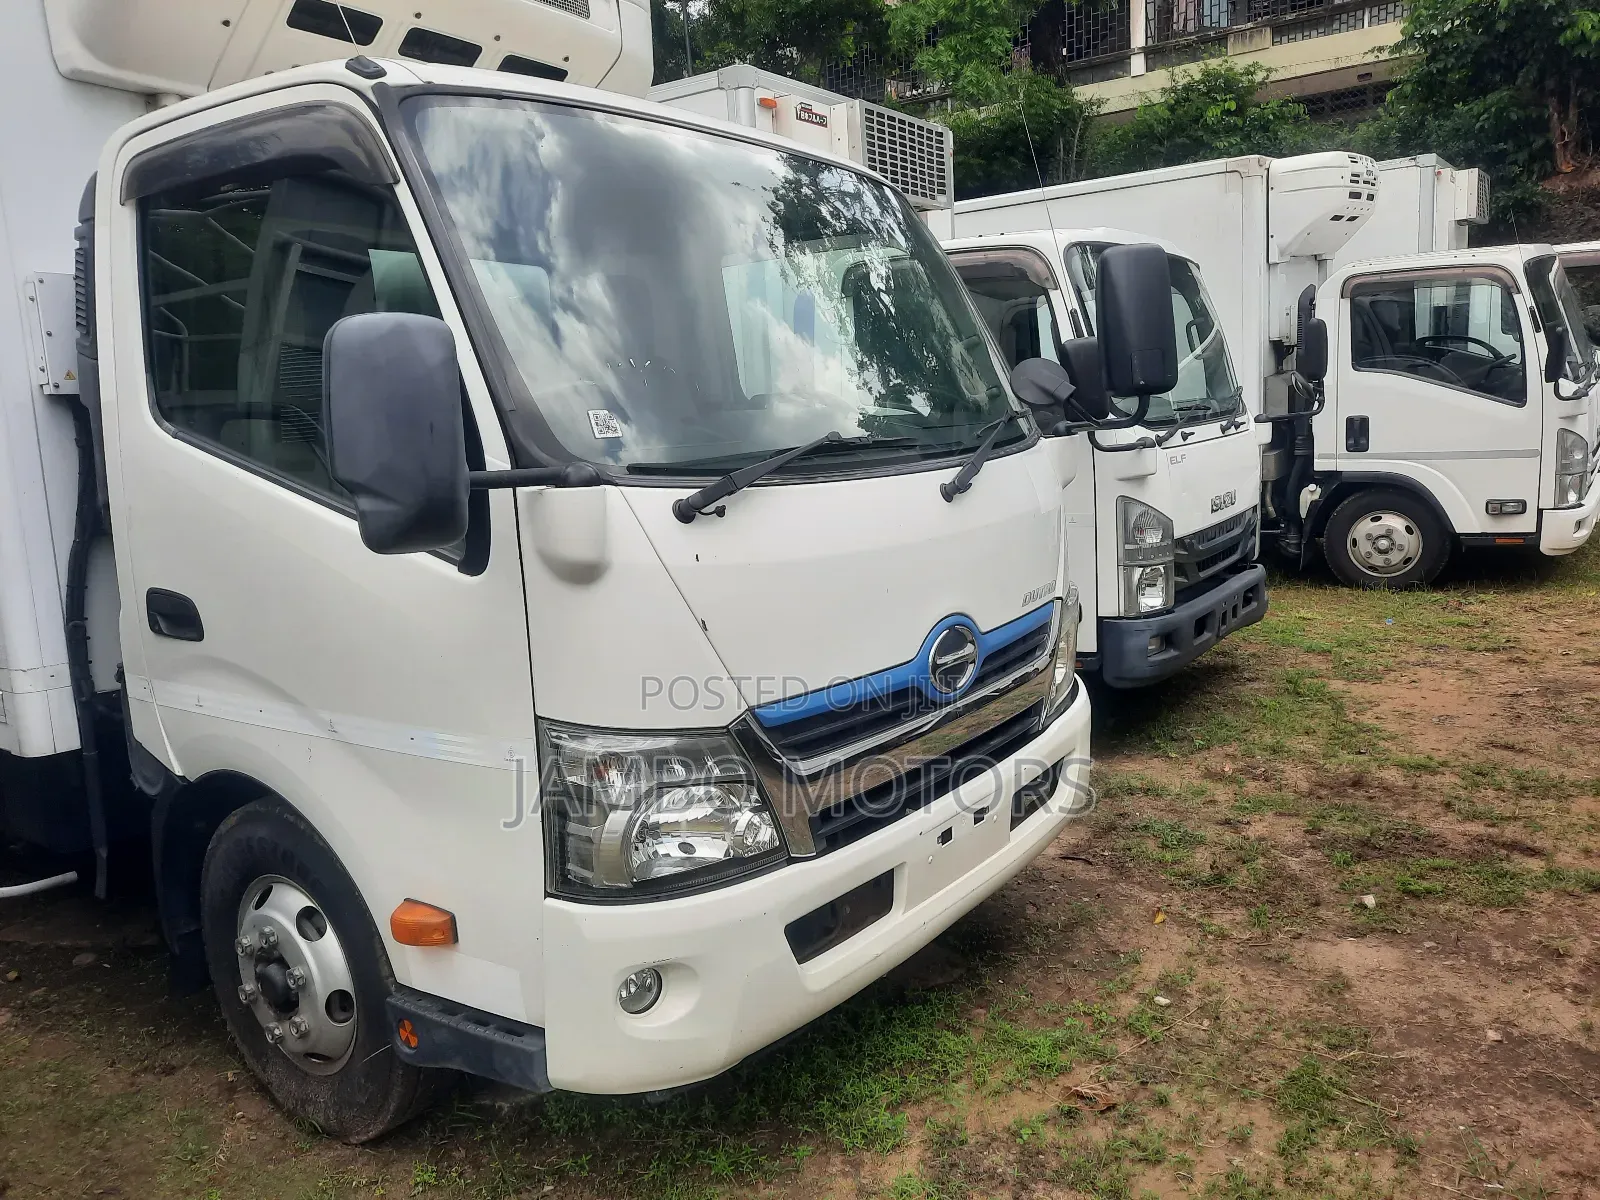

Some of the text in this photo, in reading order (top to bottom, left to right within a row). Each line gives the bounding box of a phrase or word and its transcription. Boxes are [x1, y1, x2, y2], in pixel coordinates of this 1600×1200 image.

[1169, 453, 1187, 465] ELF
[1210, 489, 1236, 514] ISUZU
[1022, 580, 1056, 607] DUTRO
